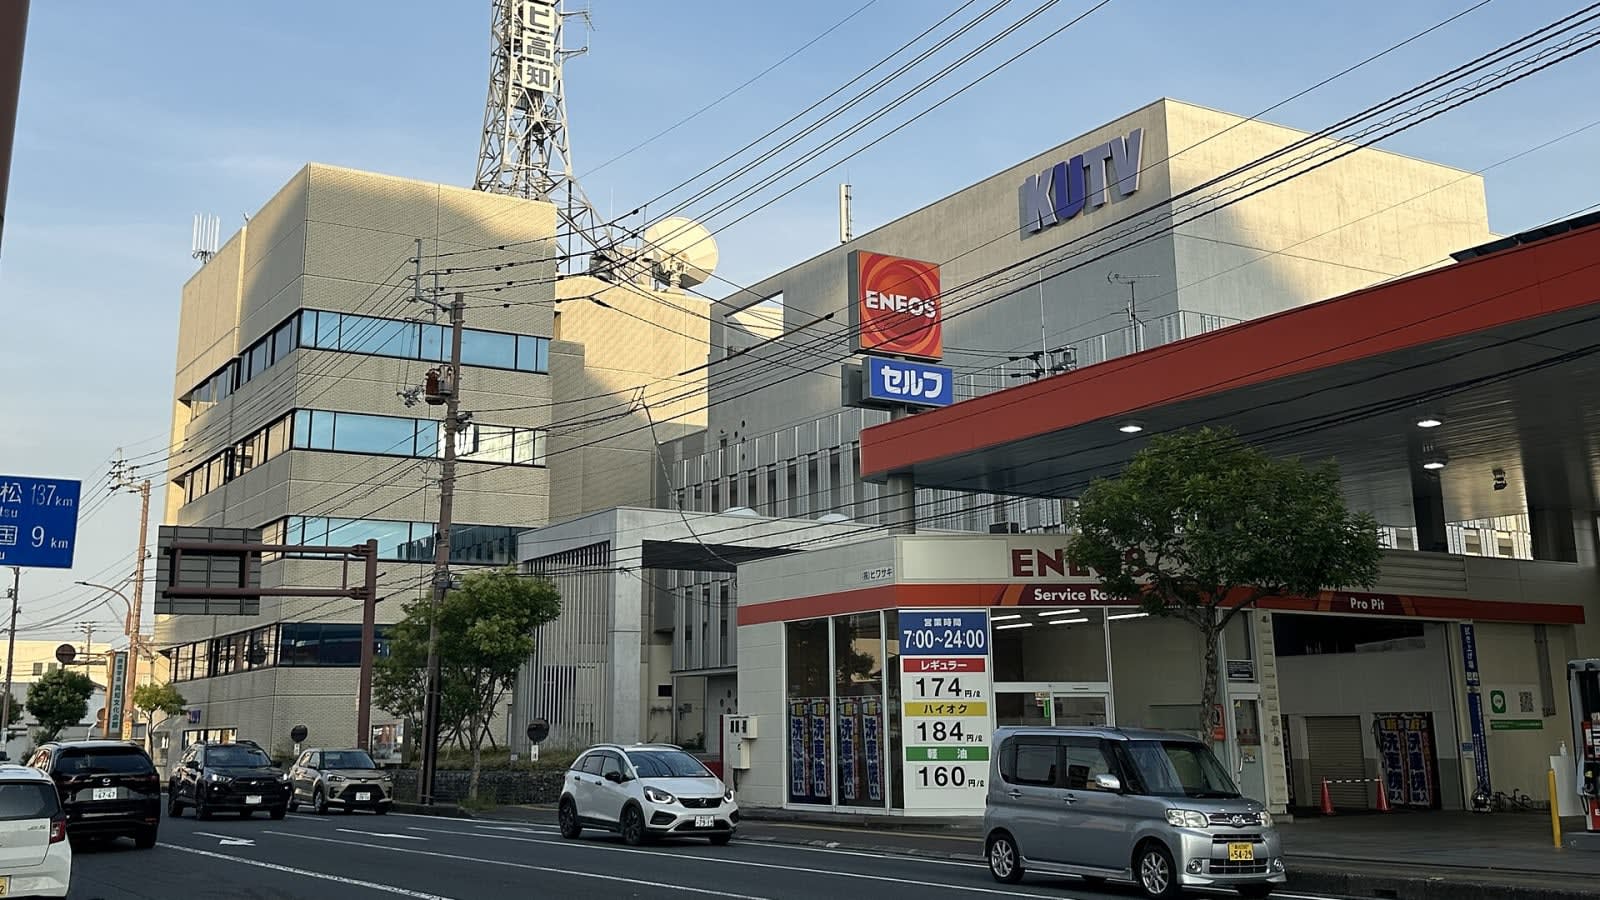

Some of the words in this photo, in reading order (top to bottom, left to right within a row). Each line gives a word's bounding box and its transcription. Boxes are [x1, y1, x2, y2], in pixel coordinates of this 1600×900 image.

[1020, 128, 1144, 234] KUTV
[865, 289, 936, 318] ENEOS
[881, 365, 943, 398] セルフ
[31, 483, 57, 506] 137
[55, 495, 73, 507] km
[31, 525, 45, 547] 9
[50, 537, 69, 549] km
[1034, 588, 1086, 601] Service
[1090, 588, 1129, 601] Ro
[1350, 597, 1368, 609] Pro
[1371, 598, 1385, 610] Pit
[921, 660, 967, 671] レギュラー
[916, 678, 962, 697] 174
[924, 704, 967, 714] ハイオク
[917, 721, 963, 742] 184
[919, 766, 966, 787] 160
